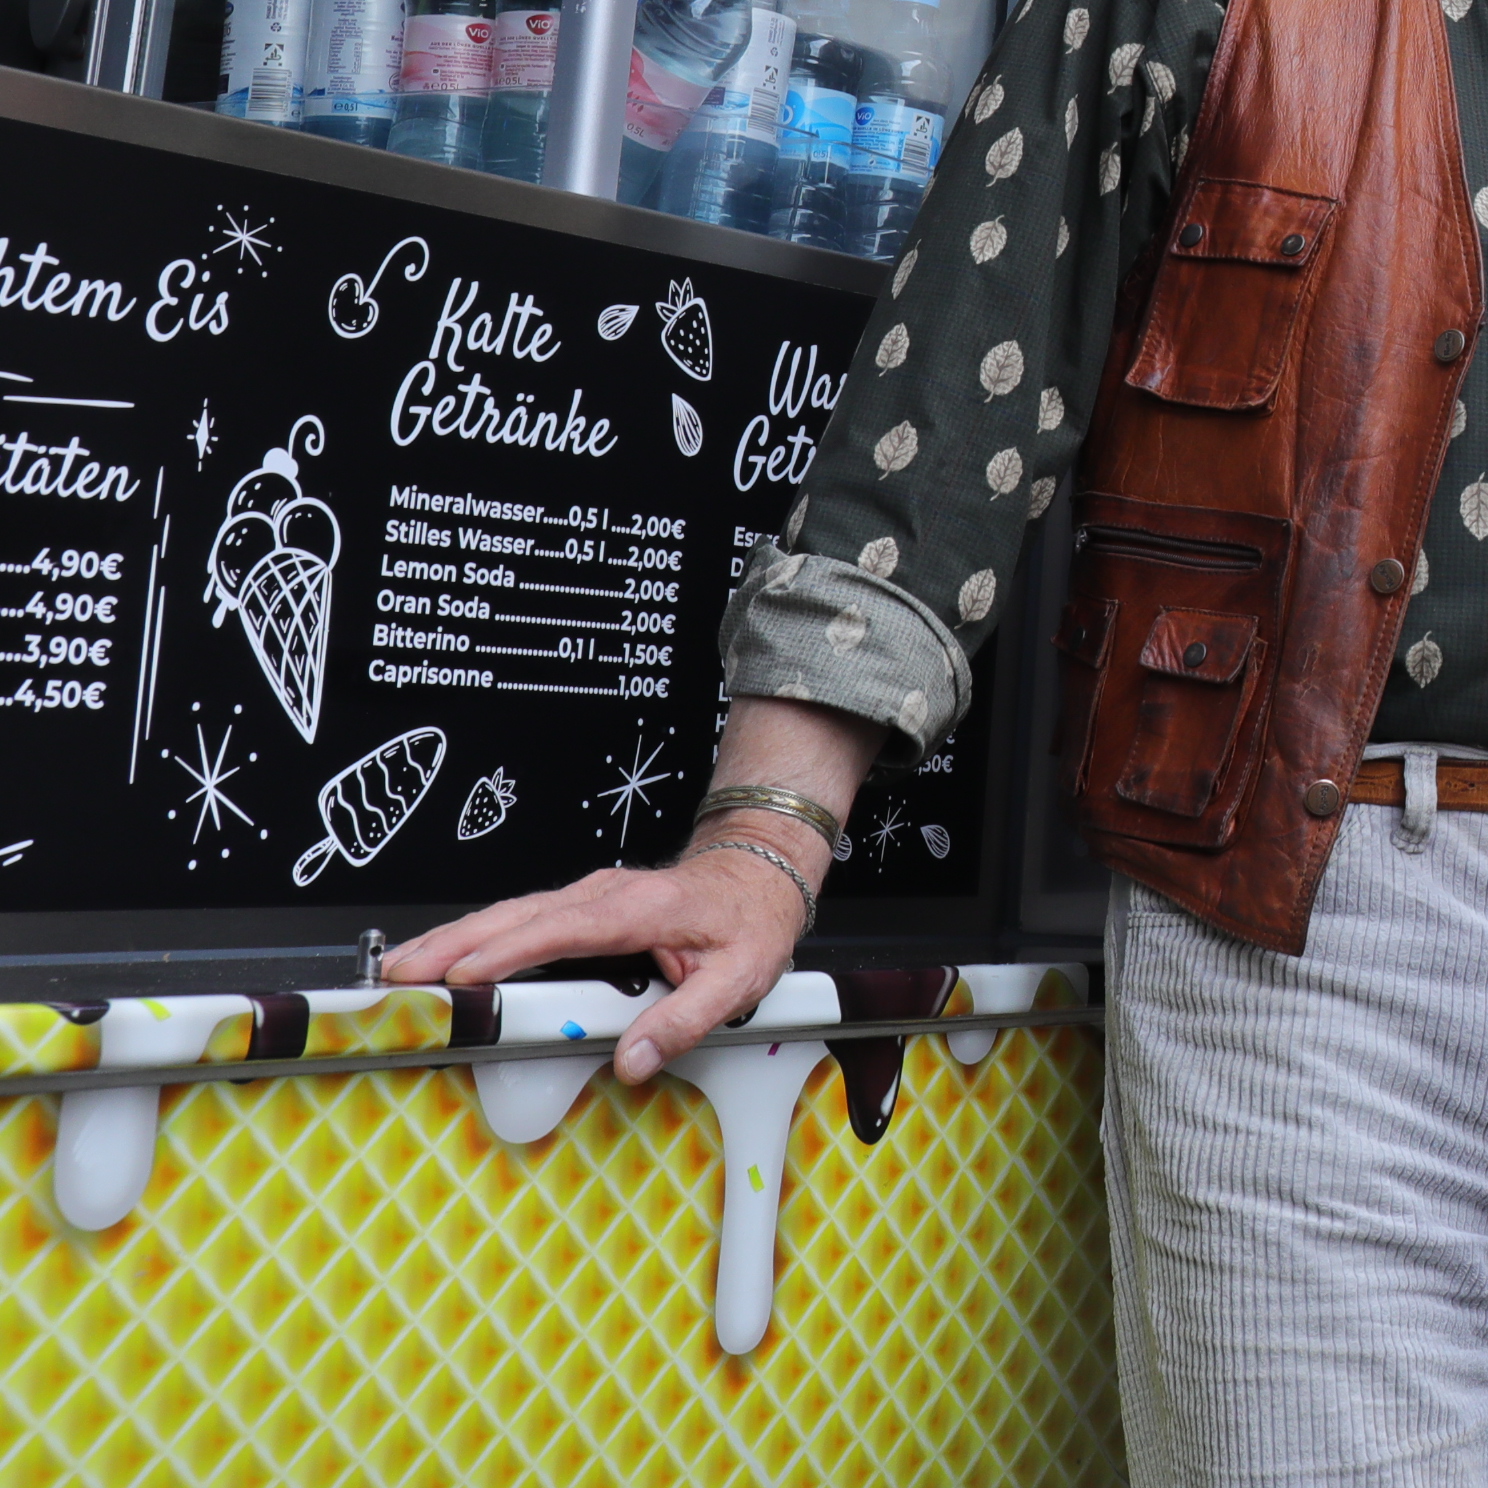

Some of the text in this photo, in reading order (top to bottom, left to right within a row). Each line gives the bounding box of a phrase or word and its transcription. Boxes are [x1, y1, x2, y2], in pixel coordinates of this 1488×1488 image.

[146, 258, 230, 343] Eis
[429, 276, 562, 373] Kalte
[390, 360, 618, 458] Getränke
[389, 484, 545, 524] Mineralwasser
[568, 505, 598, 531] 0,5
[630, 514, 686, 540] 2,00€
[384, 519, 452, 548] Stilles
[458, 526, 535, 557] Wasser
[564, 538, 594, 564] 0,5
[627, 546, 683, 572] 2,00€
[380, 553, 680, 604] Lemon Soda 2,00€
[376, 589, 676, 635] Oran Soda 2,00€
[372, 622, 470, 653] Bitterino
[621, 642, 673, 668] 1,50€
[368, 659, 670, 700] Caprisonne 1,00€
